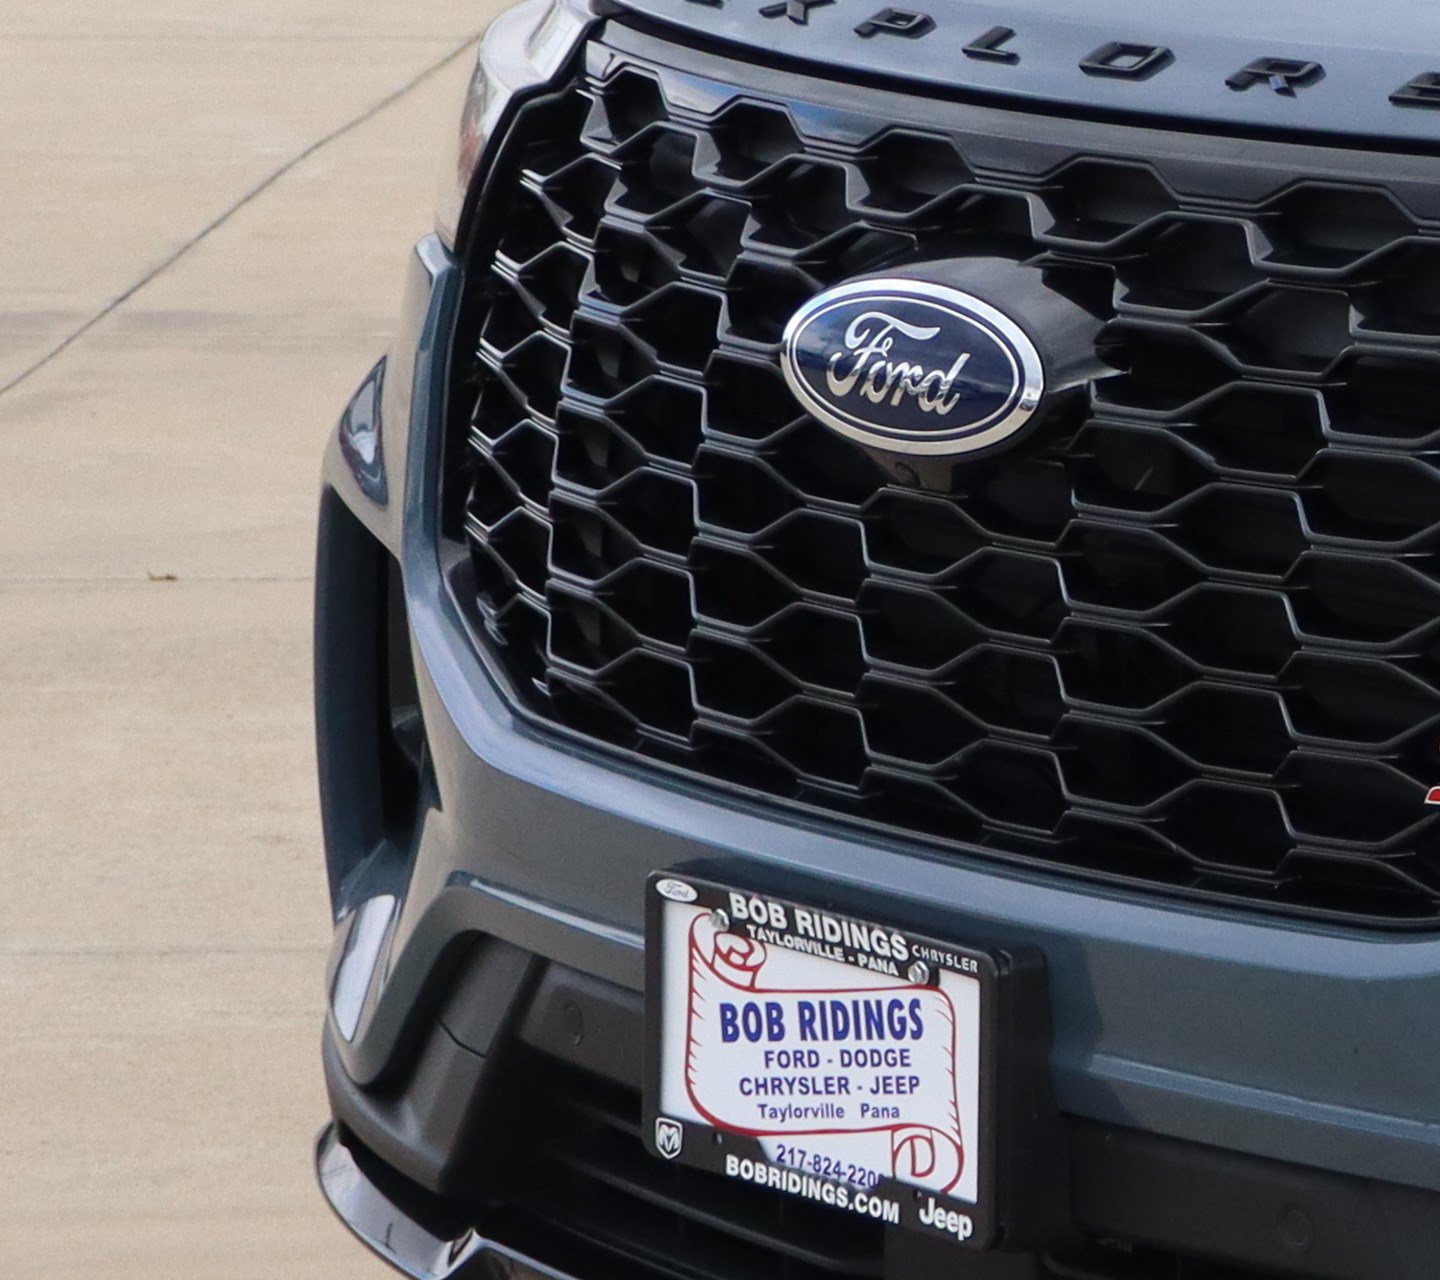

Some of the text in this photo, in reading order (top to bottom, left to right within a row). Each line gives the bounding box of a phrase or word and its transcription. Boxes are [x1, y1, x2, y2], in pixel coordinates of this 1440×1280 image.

[824, 310, 971, 417] Ford
[728, 891, 909, 962] BOB RIDINGS
[746, 924, 845, 962] TAYLORVILLE
[858, 954, 899, 977] PANA
[912, 945, 978, 974] CHRYSLER
[719, 997, 924, 1043] BOB RIDINGS
[764, 1049, 820, 1069] FORD
[840, 1048, 912, 1068] DODGE
[739, 1076, 850, 1096] CHRYSLER
[870, 1076, 920, 1096] JEEP
[757, 1103, 900, 1122] Taylorville Pana
[725, 1154, 900, 1224] BOBRIDINGS.COM
[919, 1198, 973, 1241] Jeep
